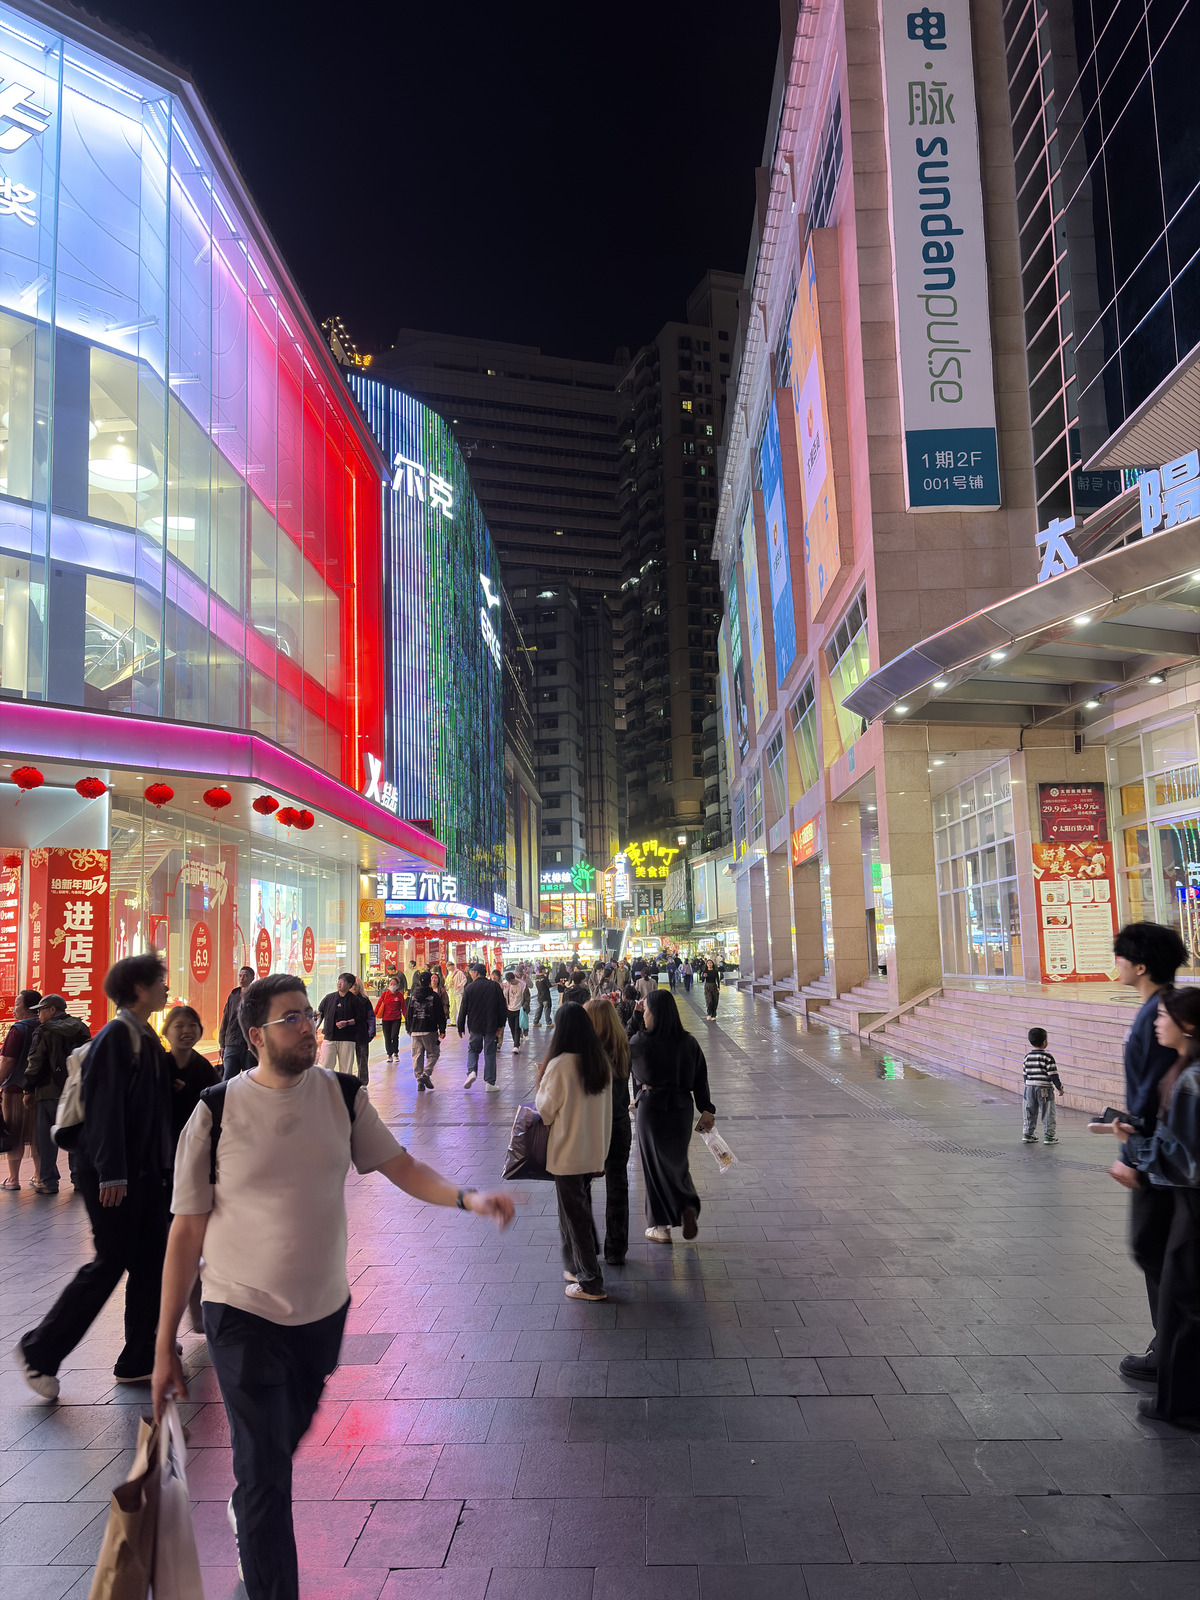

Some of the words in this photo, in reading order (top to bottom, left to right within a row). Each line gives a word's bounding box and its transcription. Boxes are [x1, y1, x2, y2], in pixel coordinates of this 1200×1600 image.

[923, 474, 984, 492] 001号铺
[635, 866, 669, 878] 美食街
